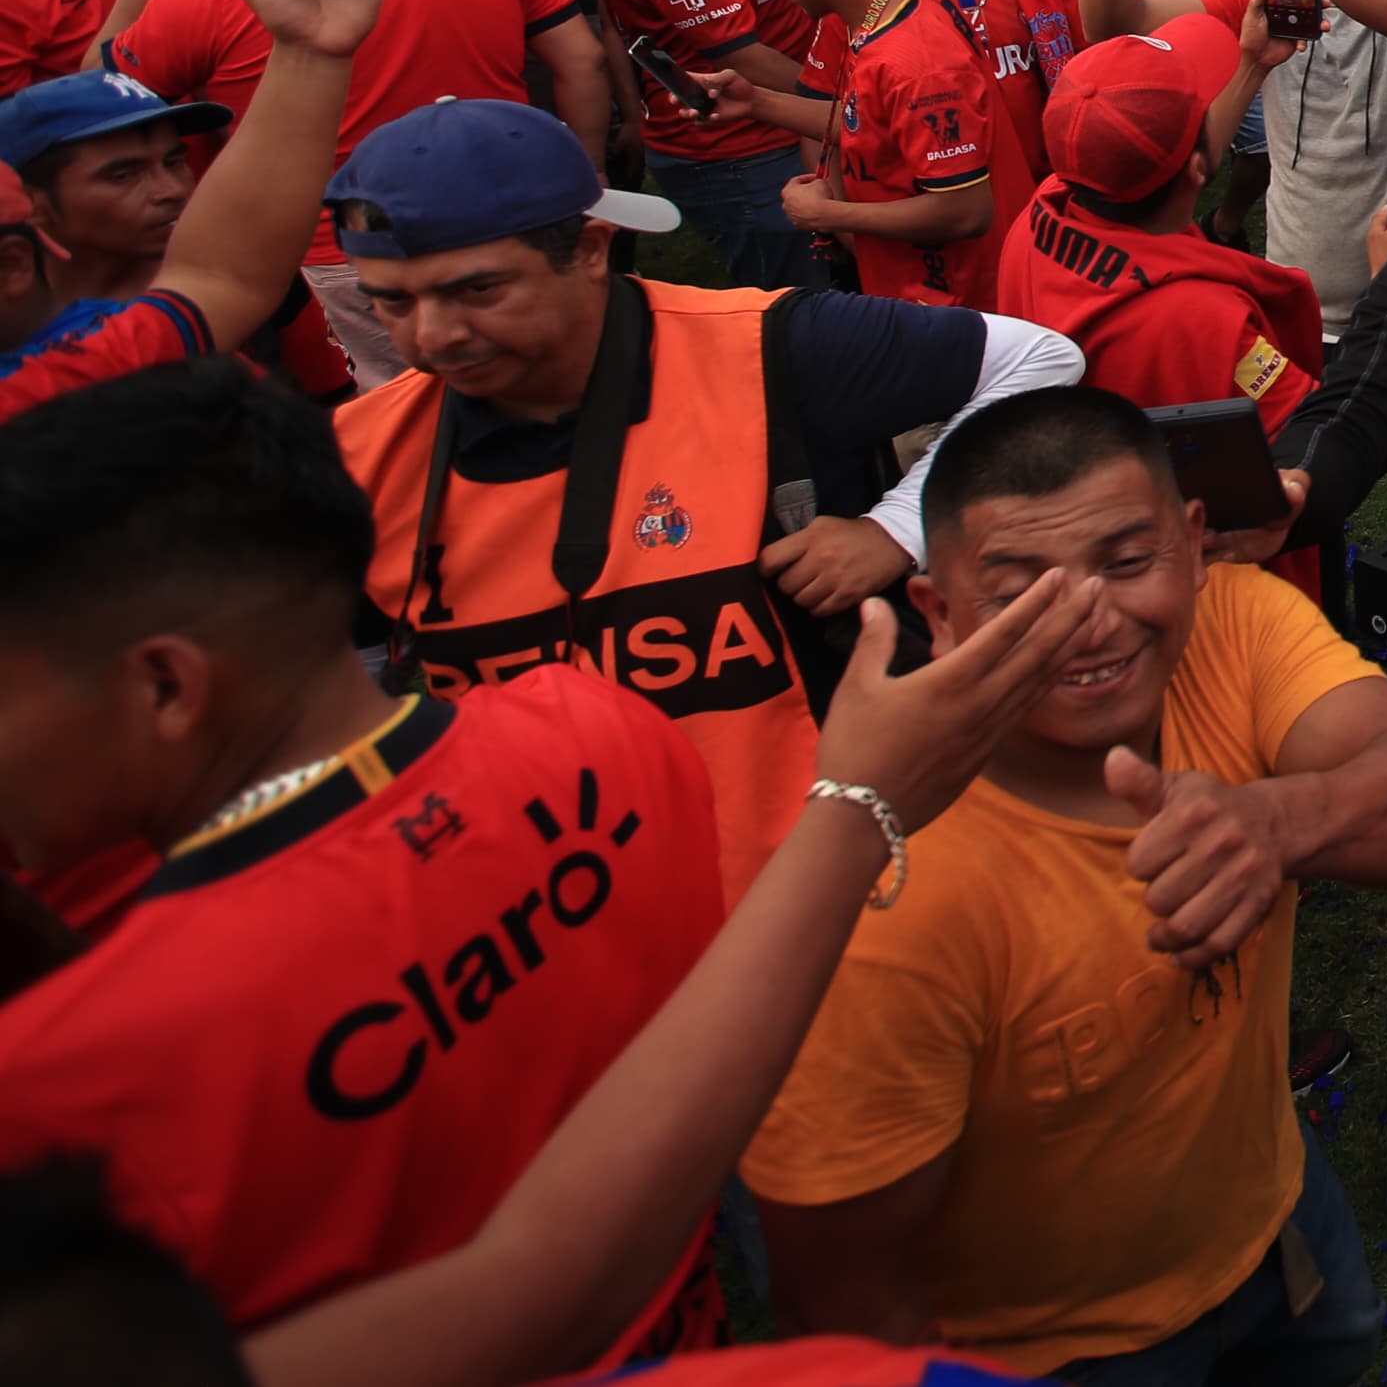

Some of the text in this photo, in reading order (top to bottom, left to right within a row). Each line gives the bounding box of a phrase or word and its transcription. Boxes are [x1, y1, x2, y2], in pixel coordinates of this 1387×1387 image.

[696, 14, 709, 25] EN
[709, 2, 742, 21] SALUD
[861, 4, 879, 30] PURO
[305, 850, 614, 1124] Claro
